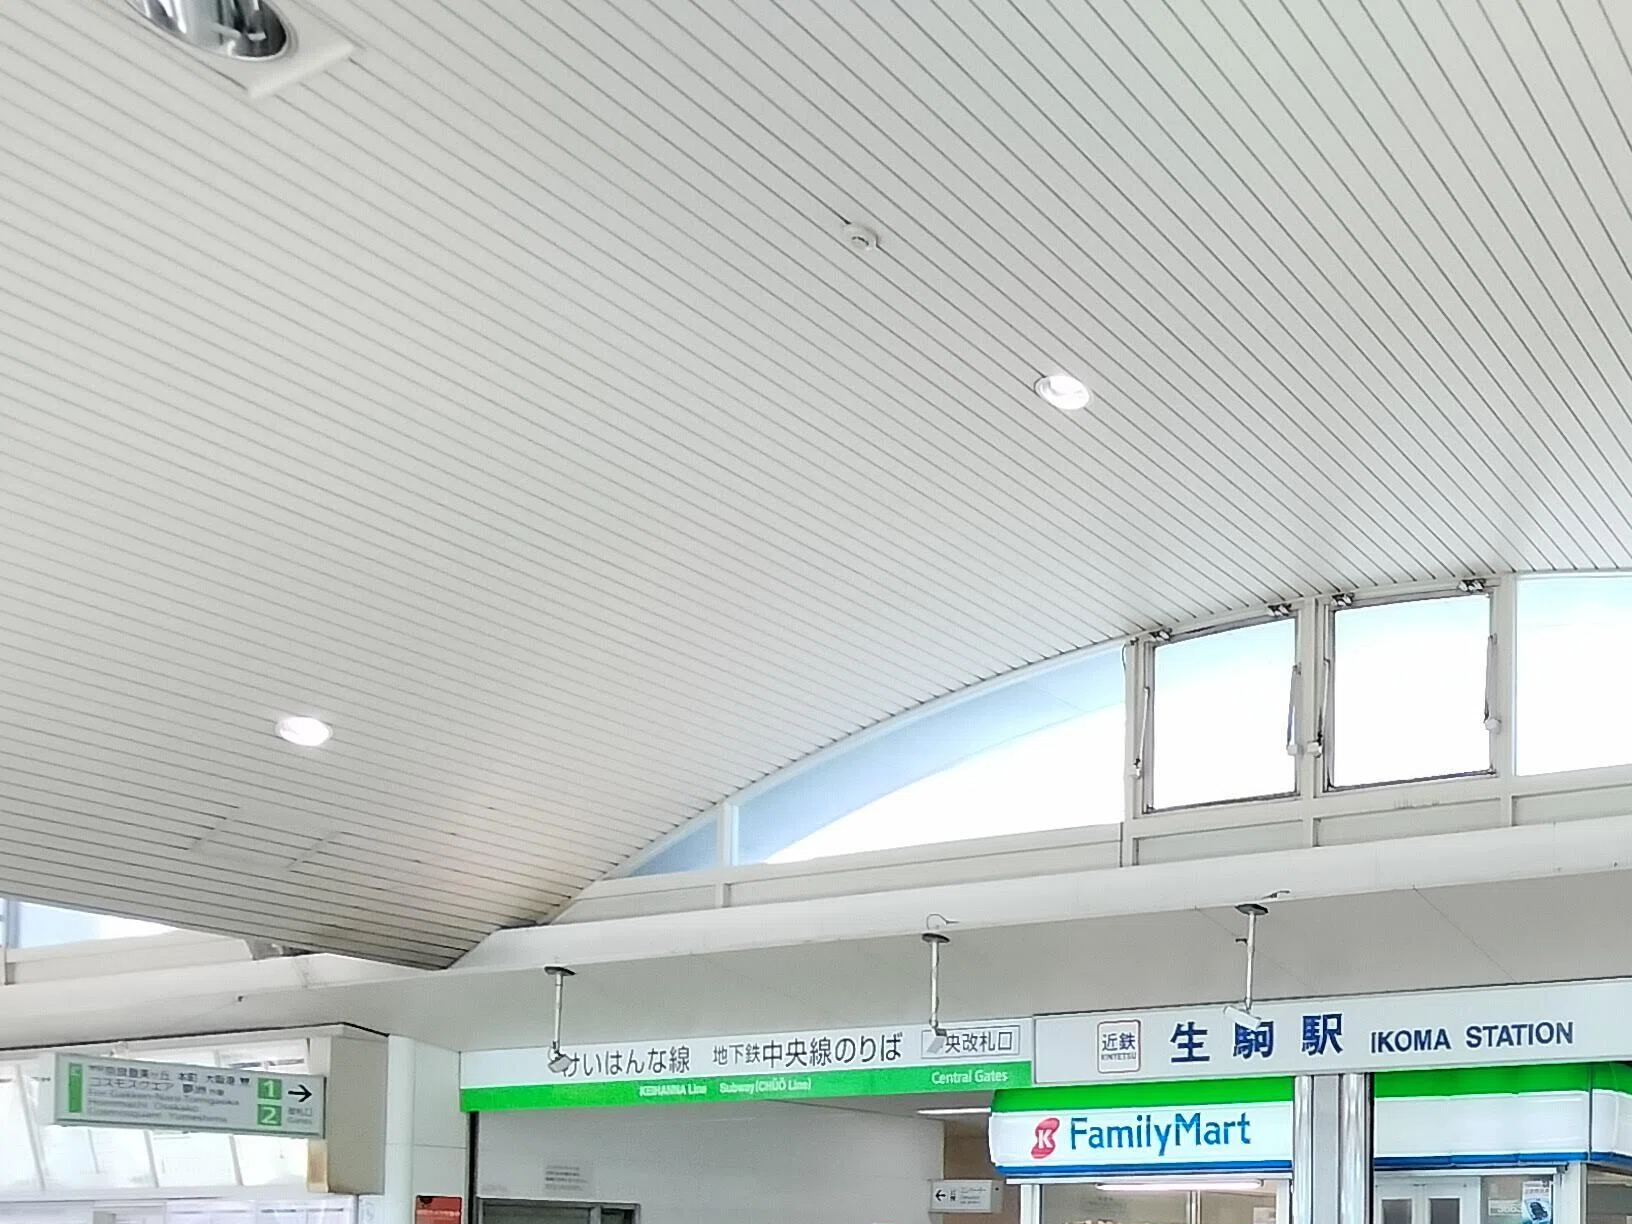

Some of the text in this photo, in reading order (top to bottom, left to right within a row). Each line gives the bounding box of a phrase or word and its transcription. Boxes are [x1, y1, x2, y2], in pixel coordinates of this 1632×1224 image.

[942, 1031, 1012, 1054] 央改札口
[1102, 1032, 1136, 1051] 近鉄
[1370, 1021, 1574, 1054] IKOMA STATION
[931, 1069, 1008, 1086] Central Gates
[262, 1080, 275, 1098] 1
[261, 1106, 278, 1124] 2
[1071, 1112, 1251, 1157] FamilyMart
